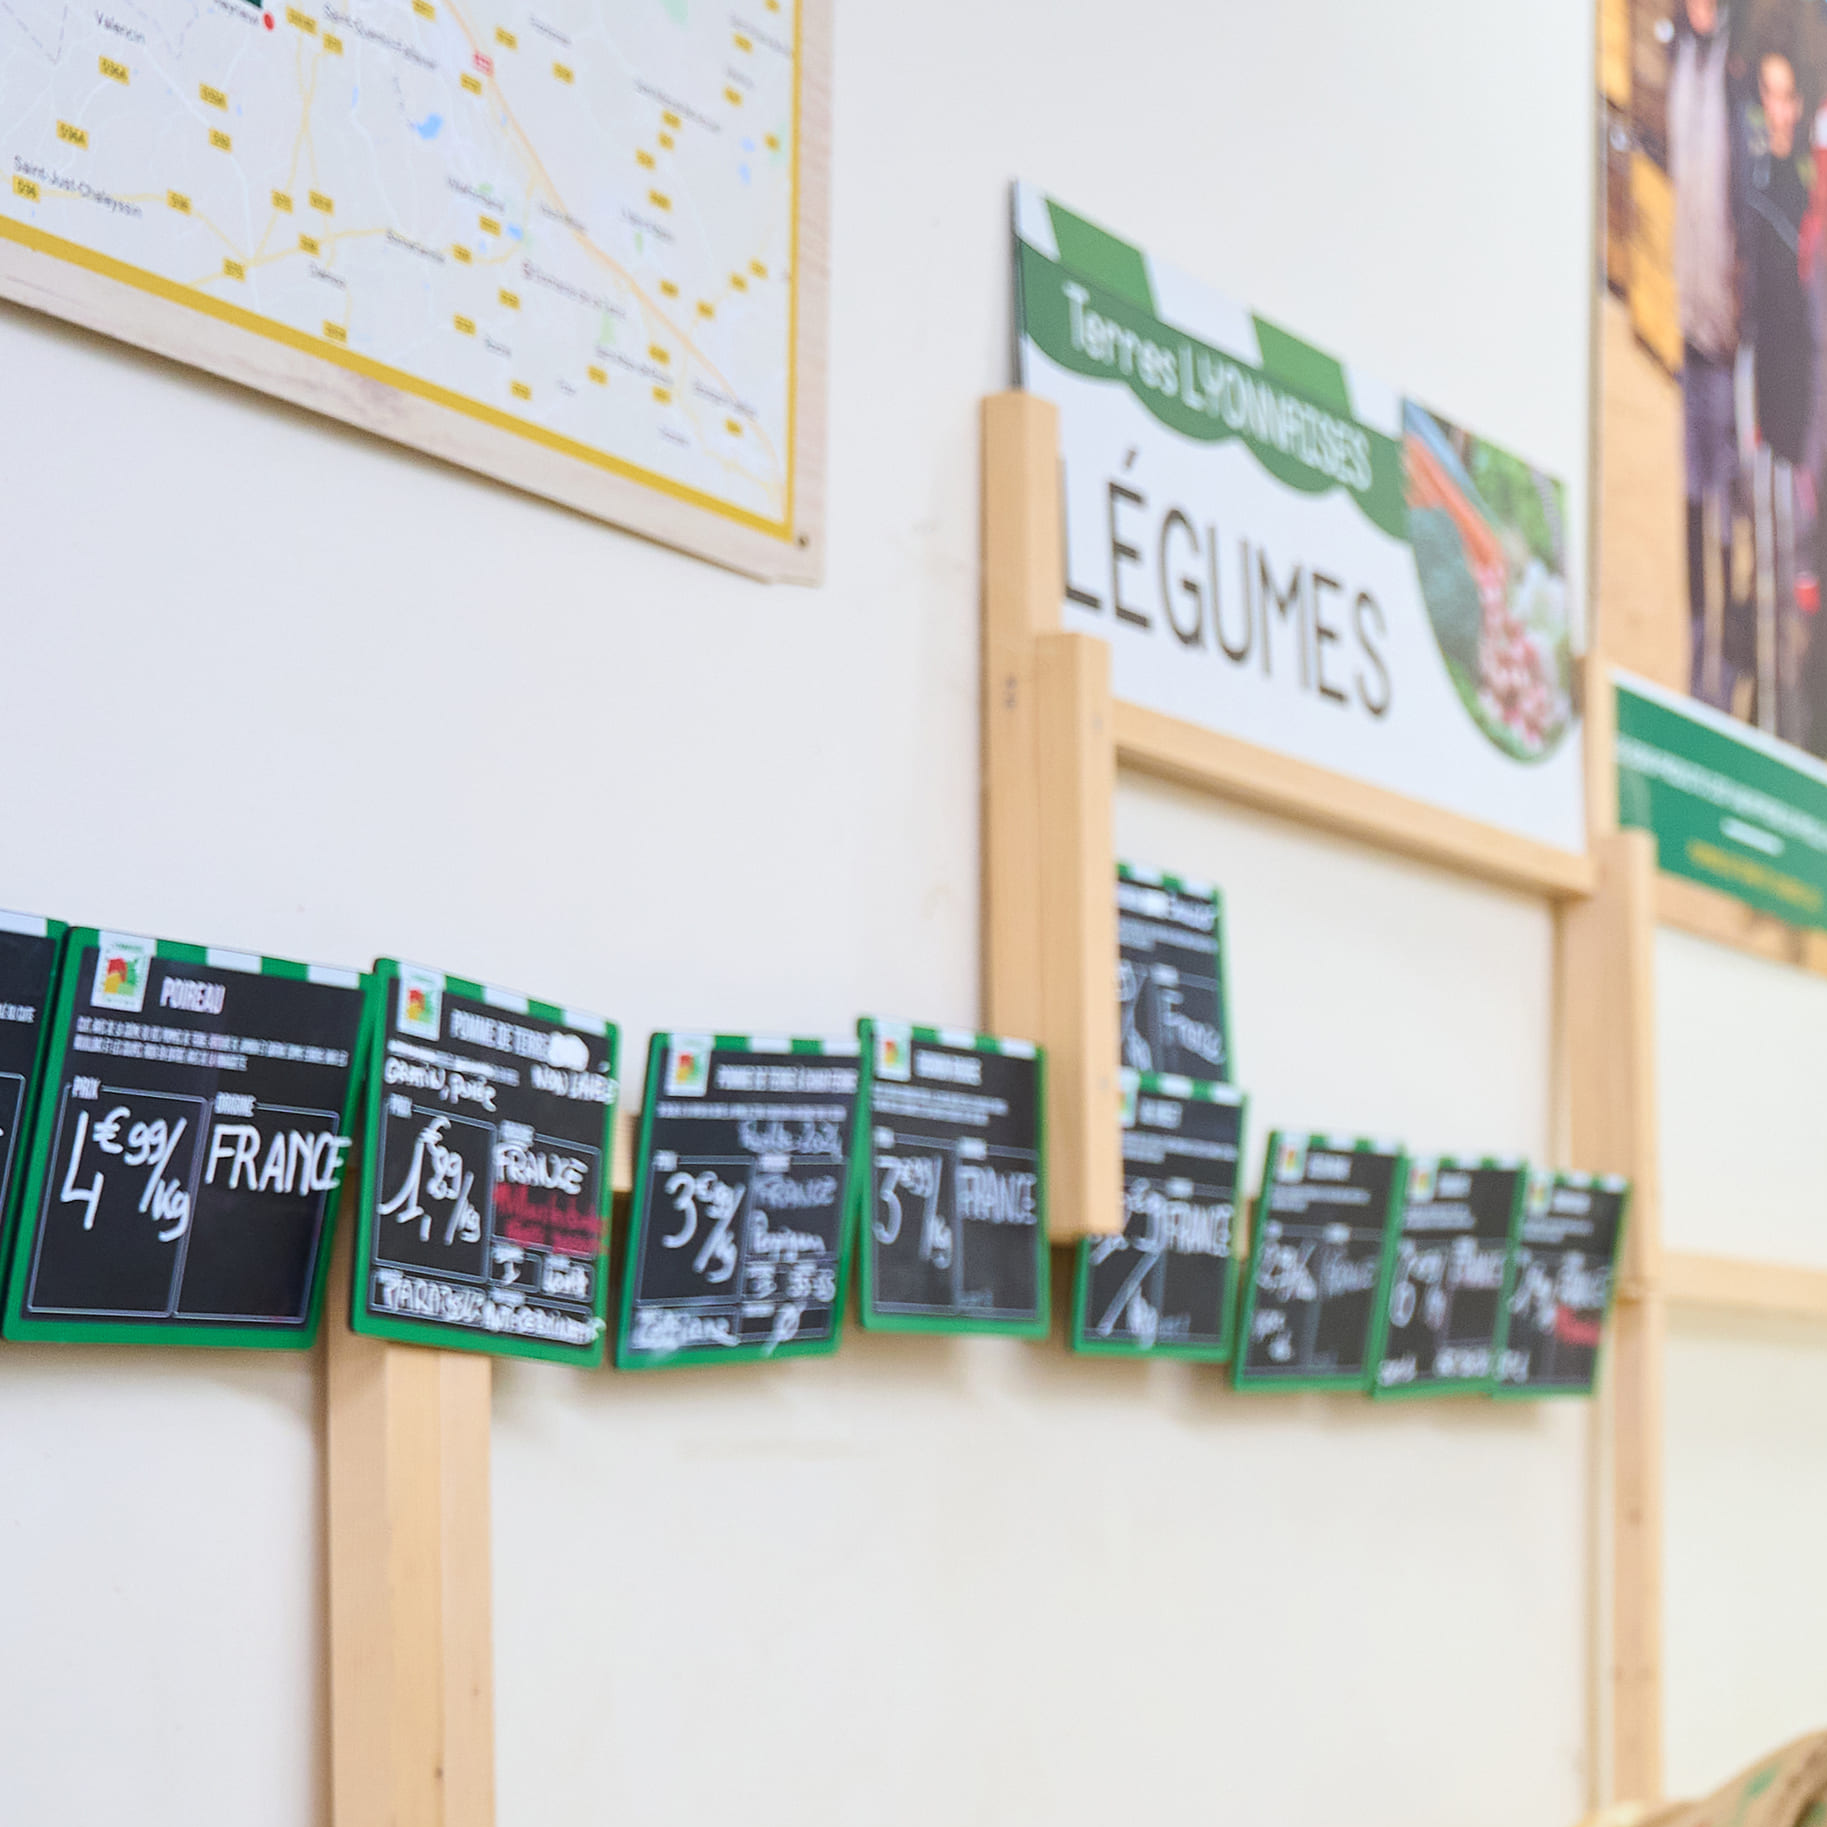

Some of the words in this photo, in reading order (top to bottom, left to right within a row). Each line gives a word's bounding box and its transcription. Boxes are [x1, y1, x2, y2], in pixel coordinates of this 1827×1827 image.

[1063, 281, 1178, 397] Terres
[1178, 341, 1372, 492] LYONNAISES
[160, 976, 226, 1016] POIREAU
[205, 1124, 352, 1196] FRANCE
